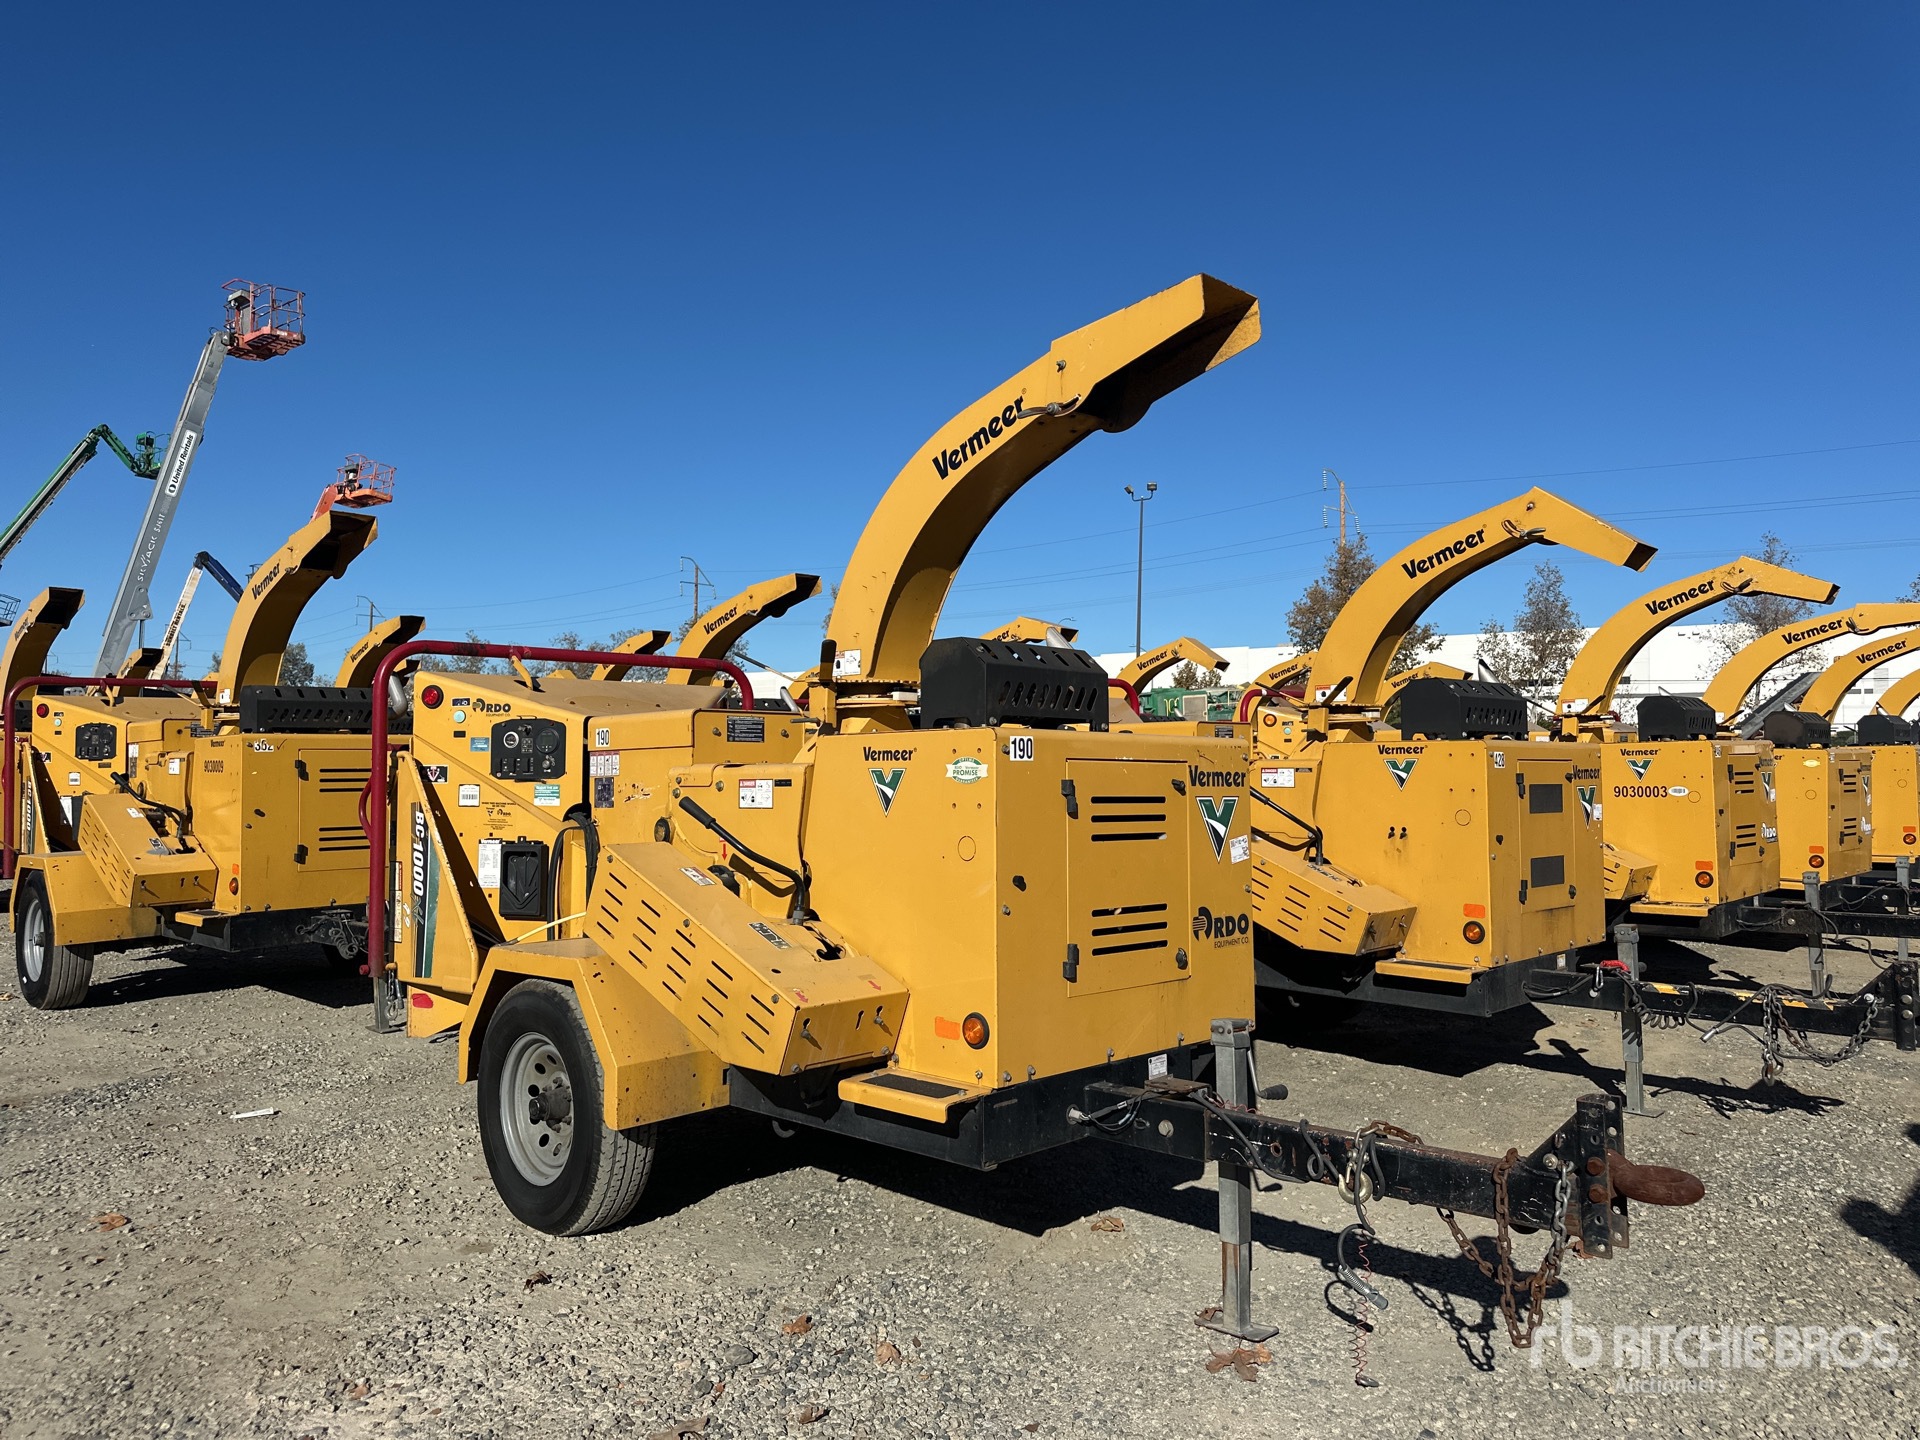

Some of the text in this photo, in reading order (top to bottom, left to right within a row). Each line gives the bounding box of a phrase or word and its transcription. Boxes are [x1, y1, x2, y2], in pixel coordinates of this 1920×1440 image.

[932, 395, 1024, 480] Vermeer
[173, 434, 195, 484] United Rentals
[137, 536, 158, 582] SKYJACK
[1401, 528, 1485, 579] Vermeer
[252, 563, 280, 600] Vermeer
[1645, 580, 1714, 615] Vermeer
[703, 606, 738, 635] Vermeer
[1781, 619, 1844, 645] Vermeer
[350, 641, 369, 663] Vermeer
[1137, 650, 1168, 671] Vermeer
[1856, 640, 1907, 664] Vermeer
[1268, 663, 1299, 681] Vermeer
[486, 703, 511, 713] RDO
[597, 729, 610, 746] 190
[1011, 737, 1033, 759] 190
[863, 746, 914, 762] Vermeer
[1377, 744, 1425, 755] Vermeer
[1620, 748, 1659, 757] Vermeer
[1188, 765, 1247, 788] Vermeer
[1573, 765, 1600, 780] Vermeer
[1613, 785, 1668, 798] 9030003
[1214, 913, 1250, 939] RDO
[1214, 937, 1241, 949] EQUIPMENT
